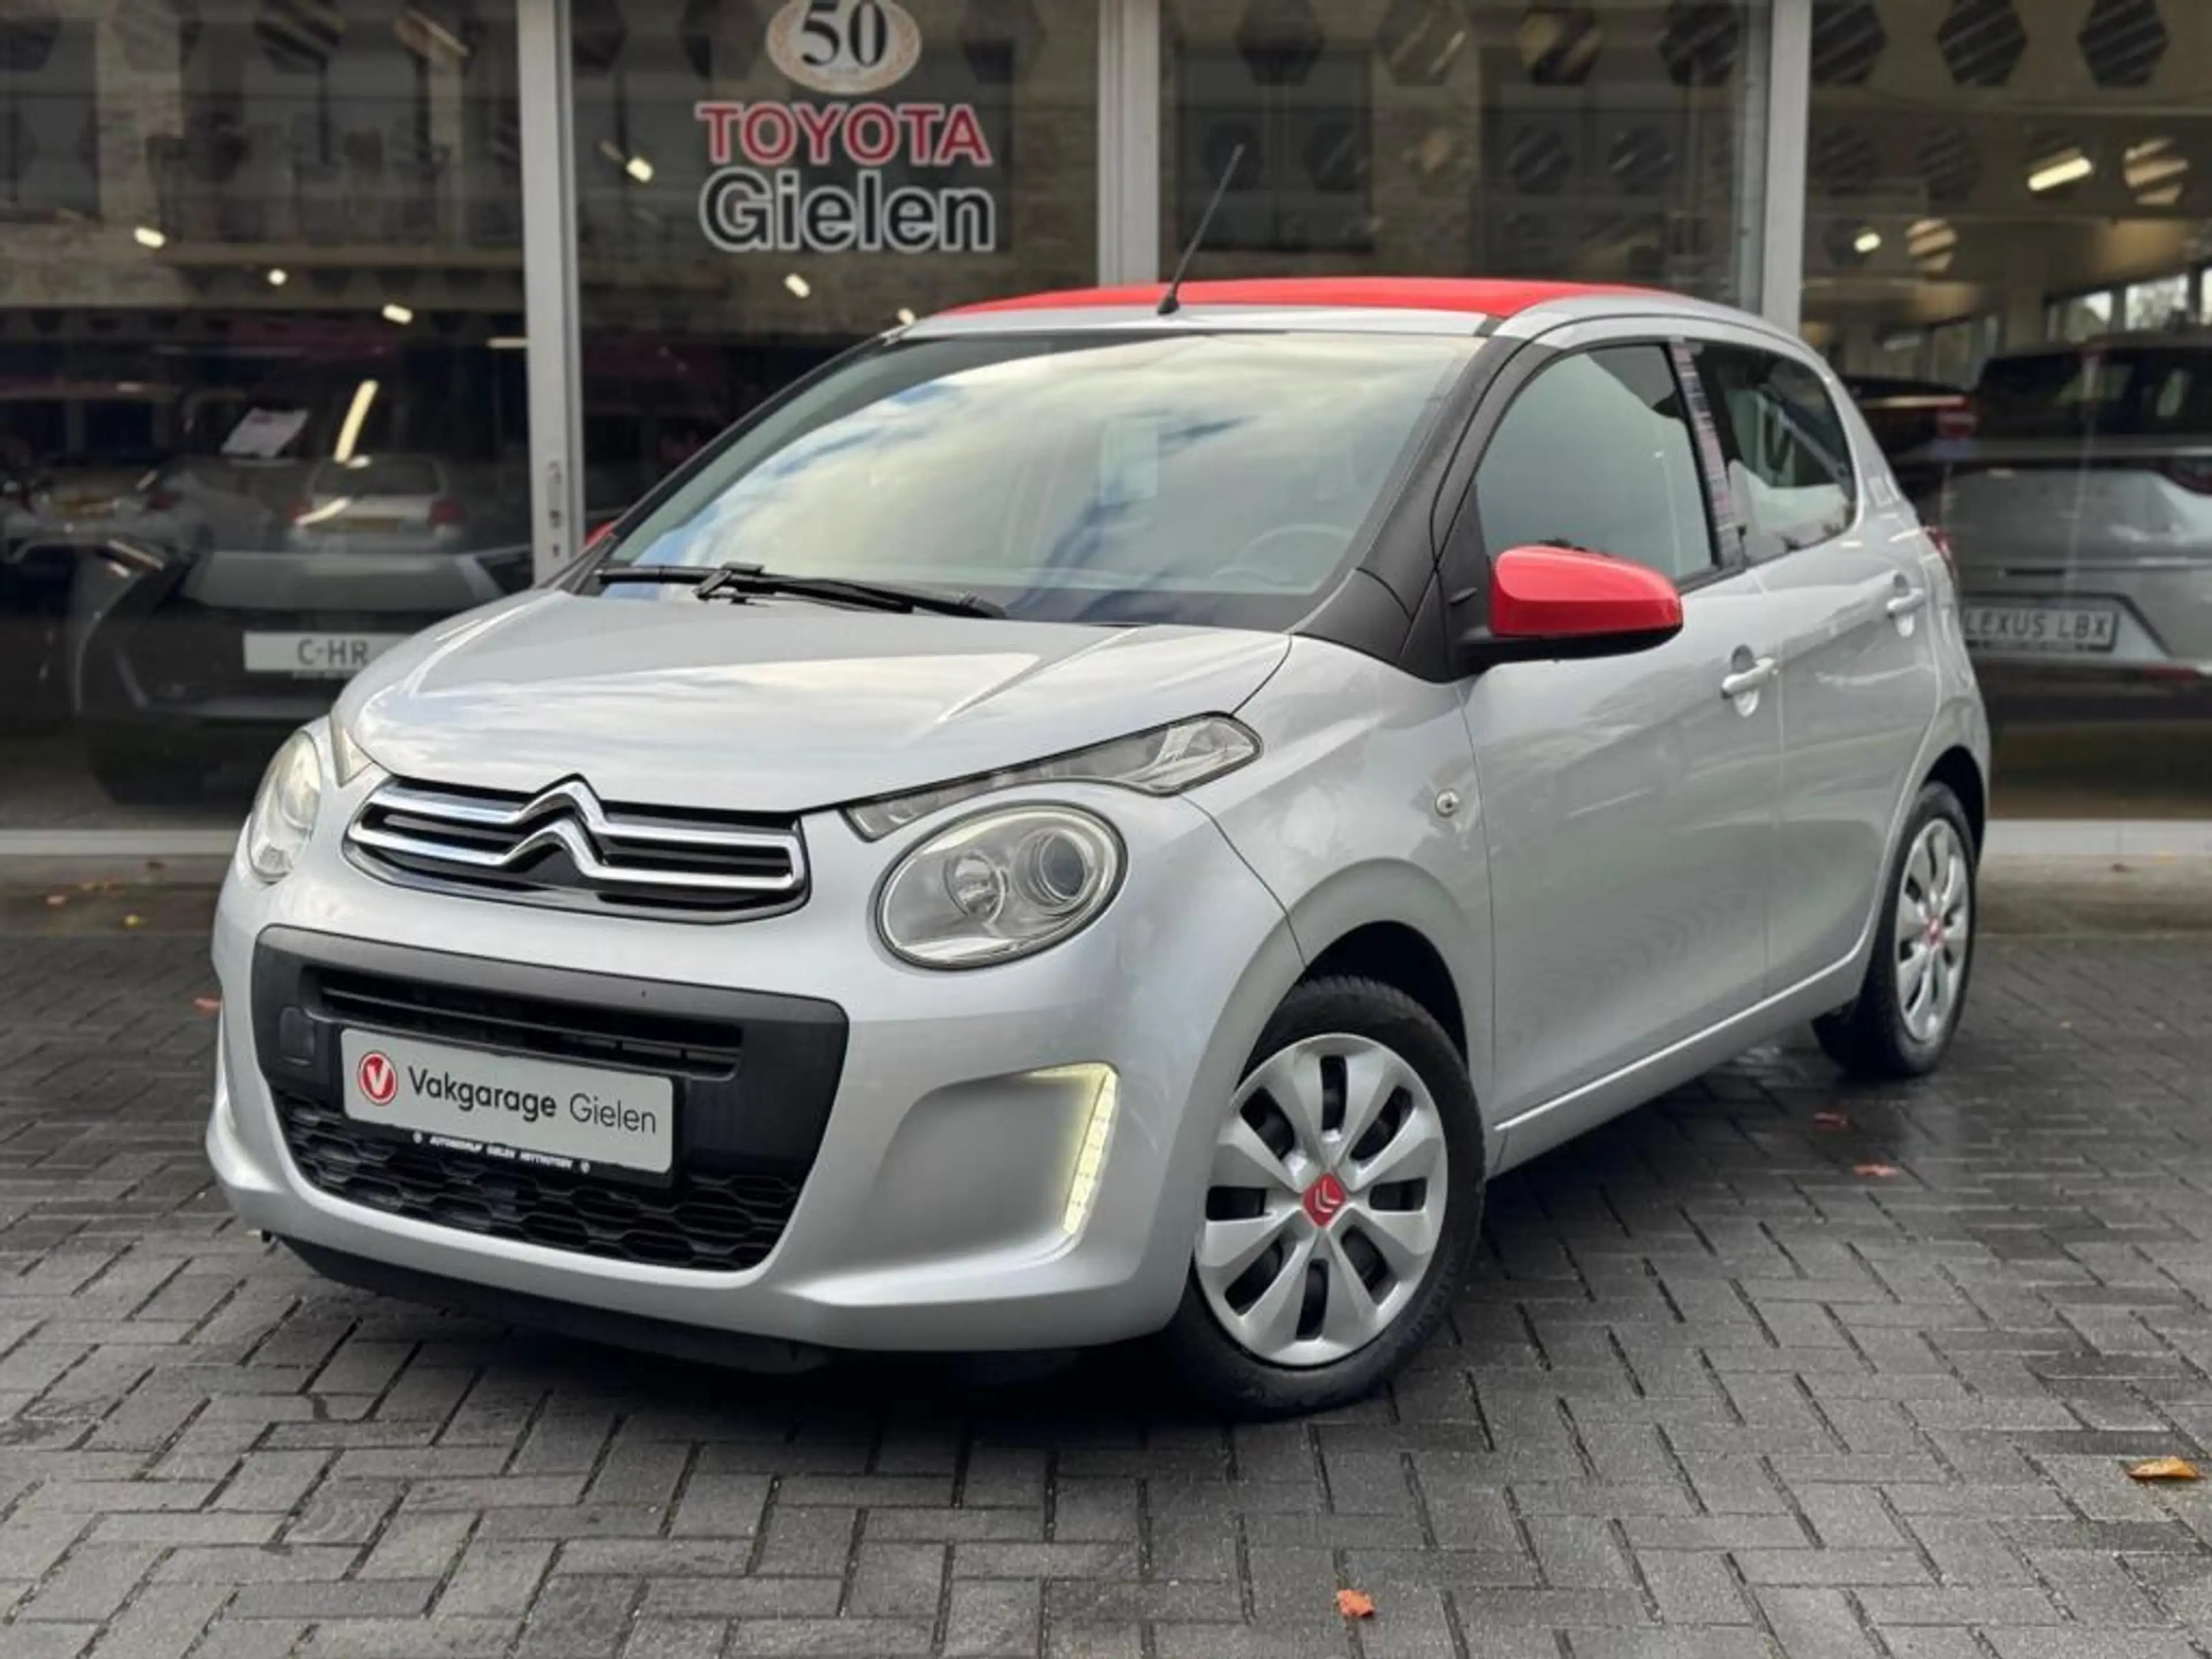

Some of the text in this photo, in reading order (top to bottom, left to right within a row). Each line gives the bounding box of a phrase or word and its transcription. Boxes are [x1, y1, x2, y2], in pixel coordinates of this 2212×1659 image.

[801, 0, 888, 66] 50
[696, 103, 993, 165] TOYOTA
[699, 168, 995, 252] Gielen
[297, 638, 370, 666] C-HR
[1964, 611, 2109, 638] LEXUS LBX
[408, 1066, 656, 1134] Vakgarage Gielen
